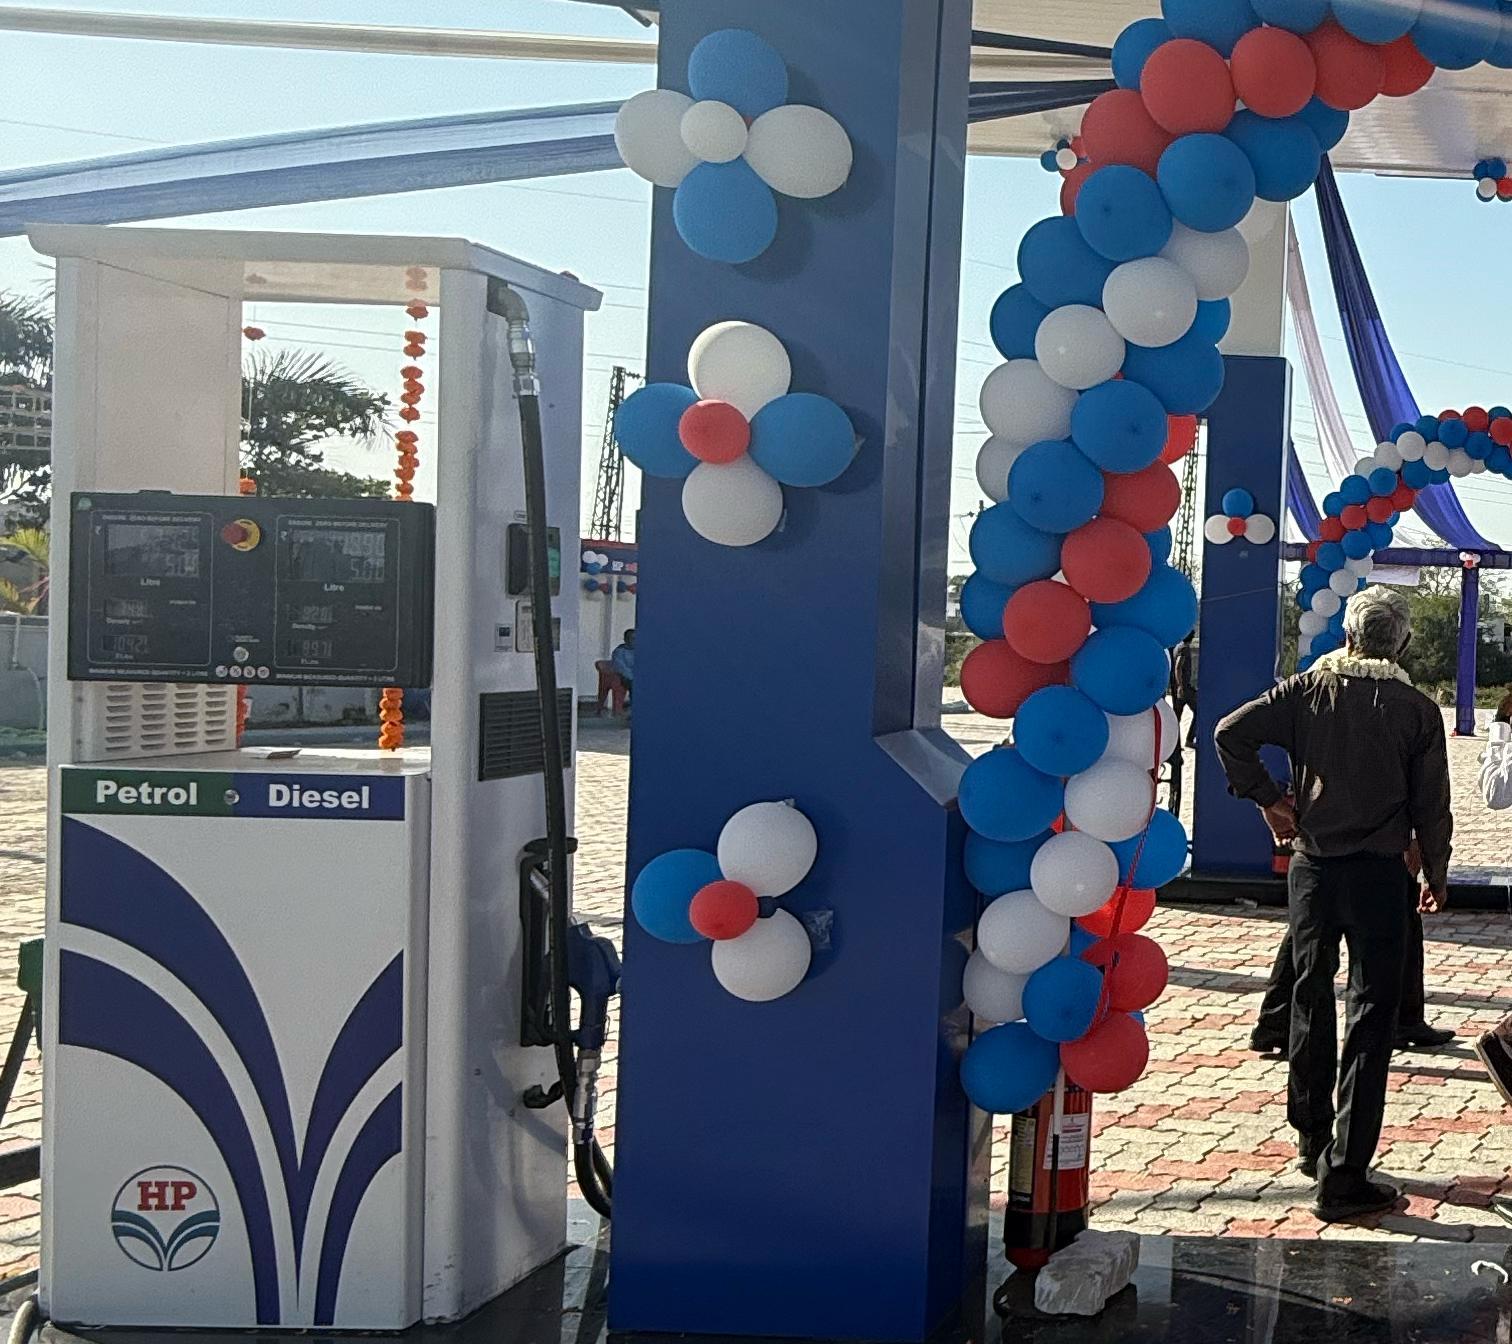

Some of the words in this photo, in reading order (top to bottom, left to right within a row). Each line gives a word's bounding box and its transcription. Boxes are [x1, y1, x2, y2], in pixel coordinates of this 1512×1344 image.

[324, 583, 345, 592] Litre
[96, 780, 197, 805] Petrol
[268, 783, 370, 809] Diesel
[137, 1181, 197, 1211] HP
